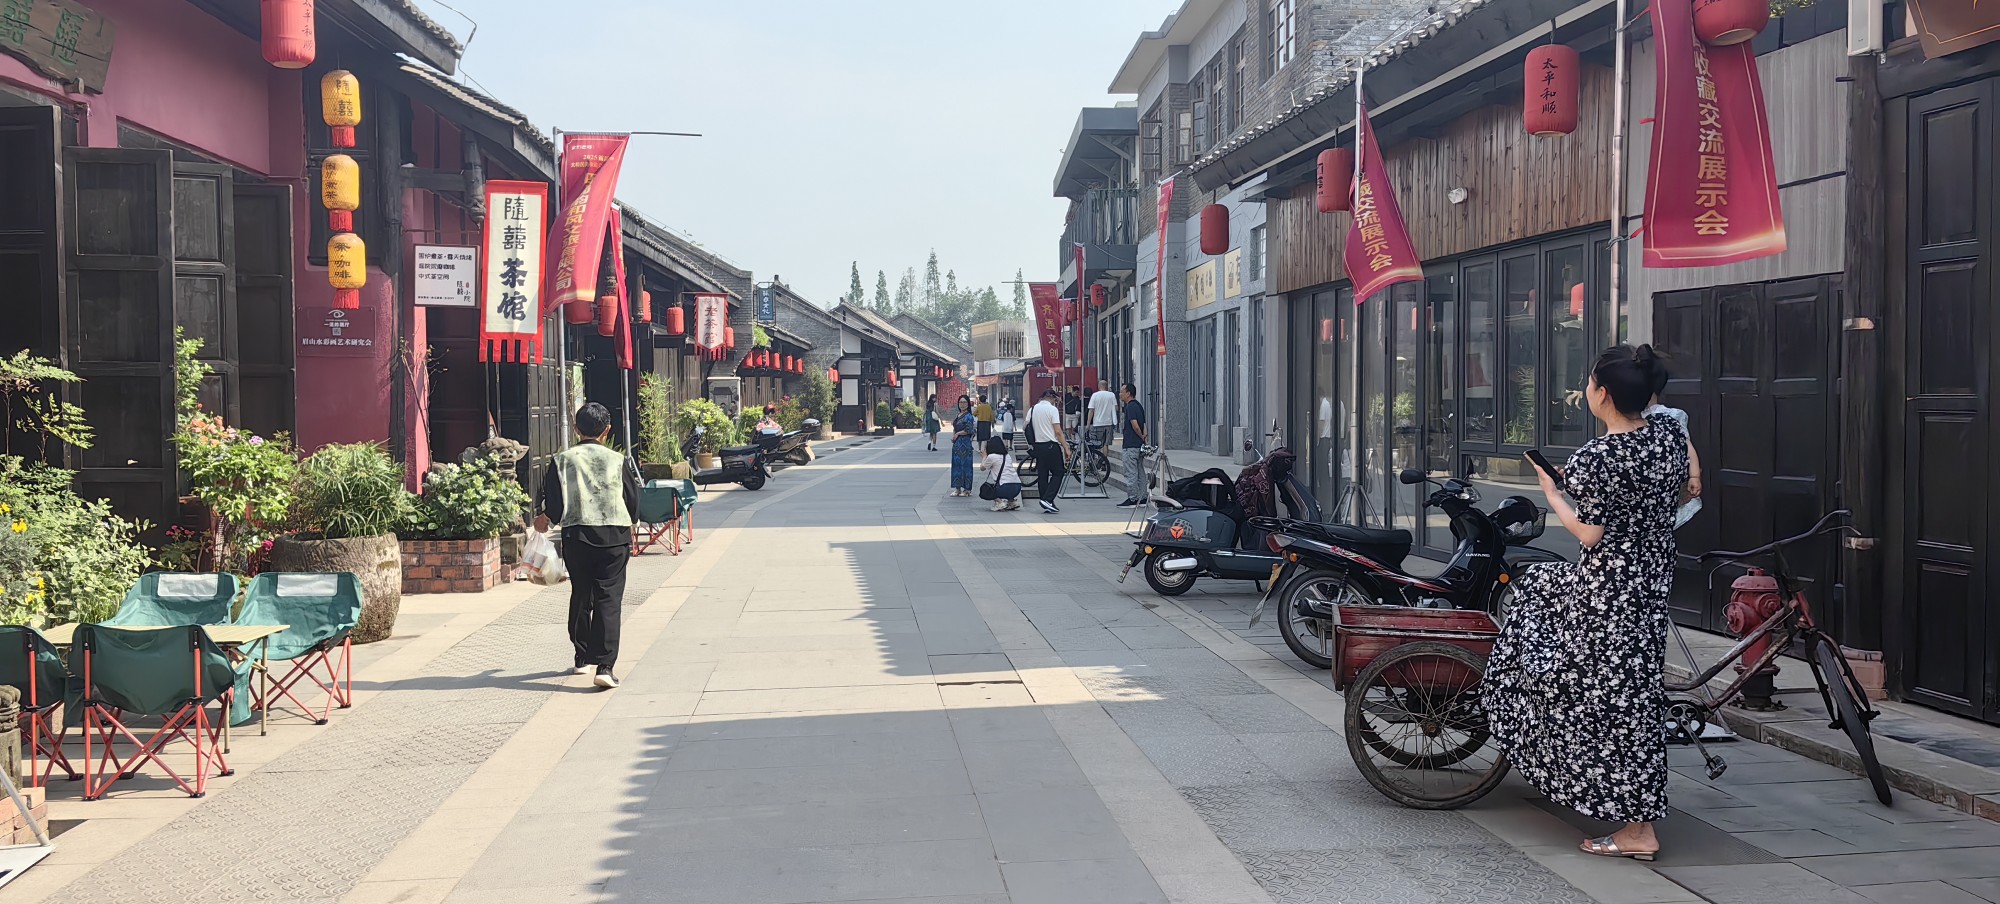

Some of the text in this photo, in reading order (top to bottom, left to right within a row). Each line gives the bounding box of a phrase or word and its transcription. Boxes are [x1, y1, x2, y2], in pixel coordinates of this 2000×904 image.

[1540, 57, 1558, 114] 太平和顺
[1691, 38, 1729, 236] 收藏交流展示会
